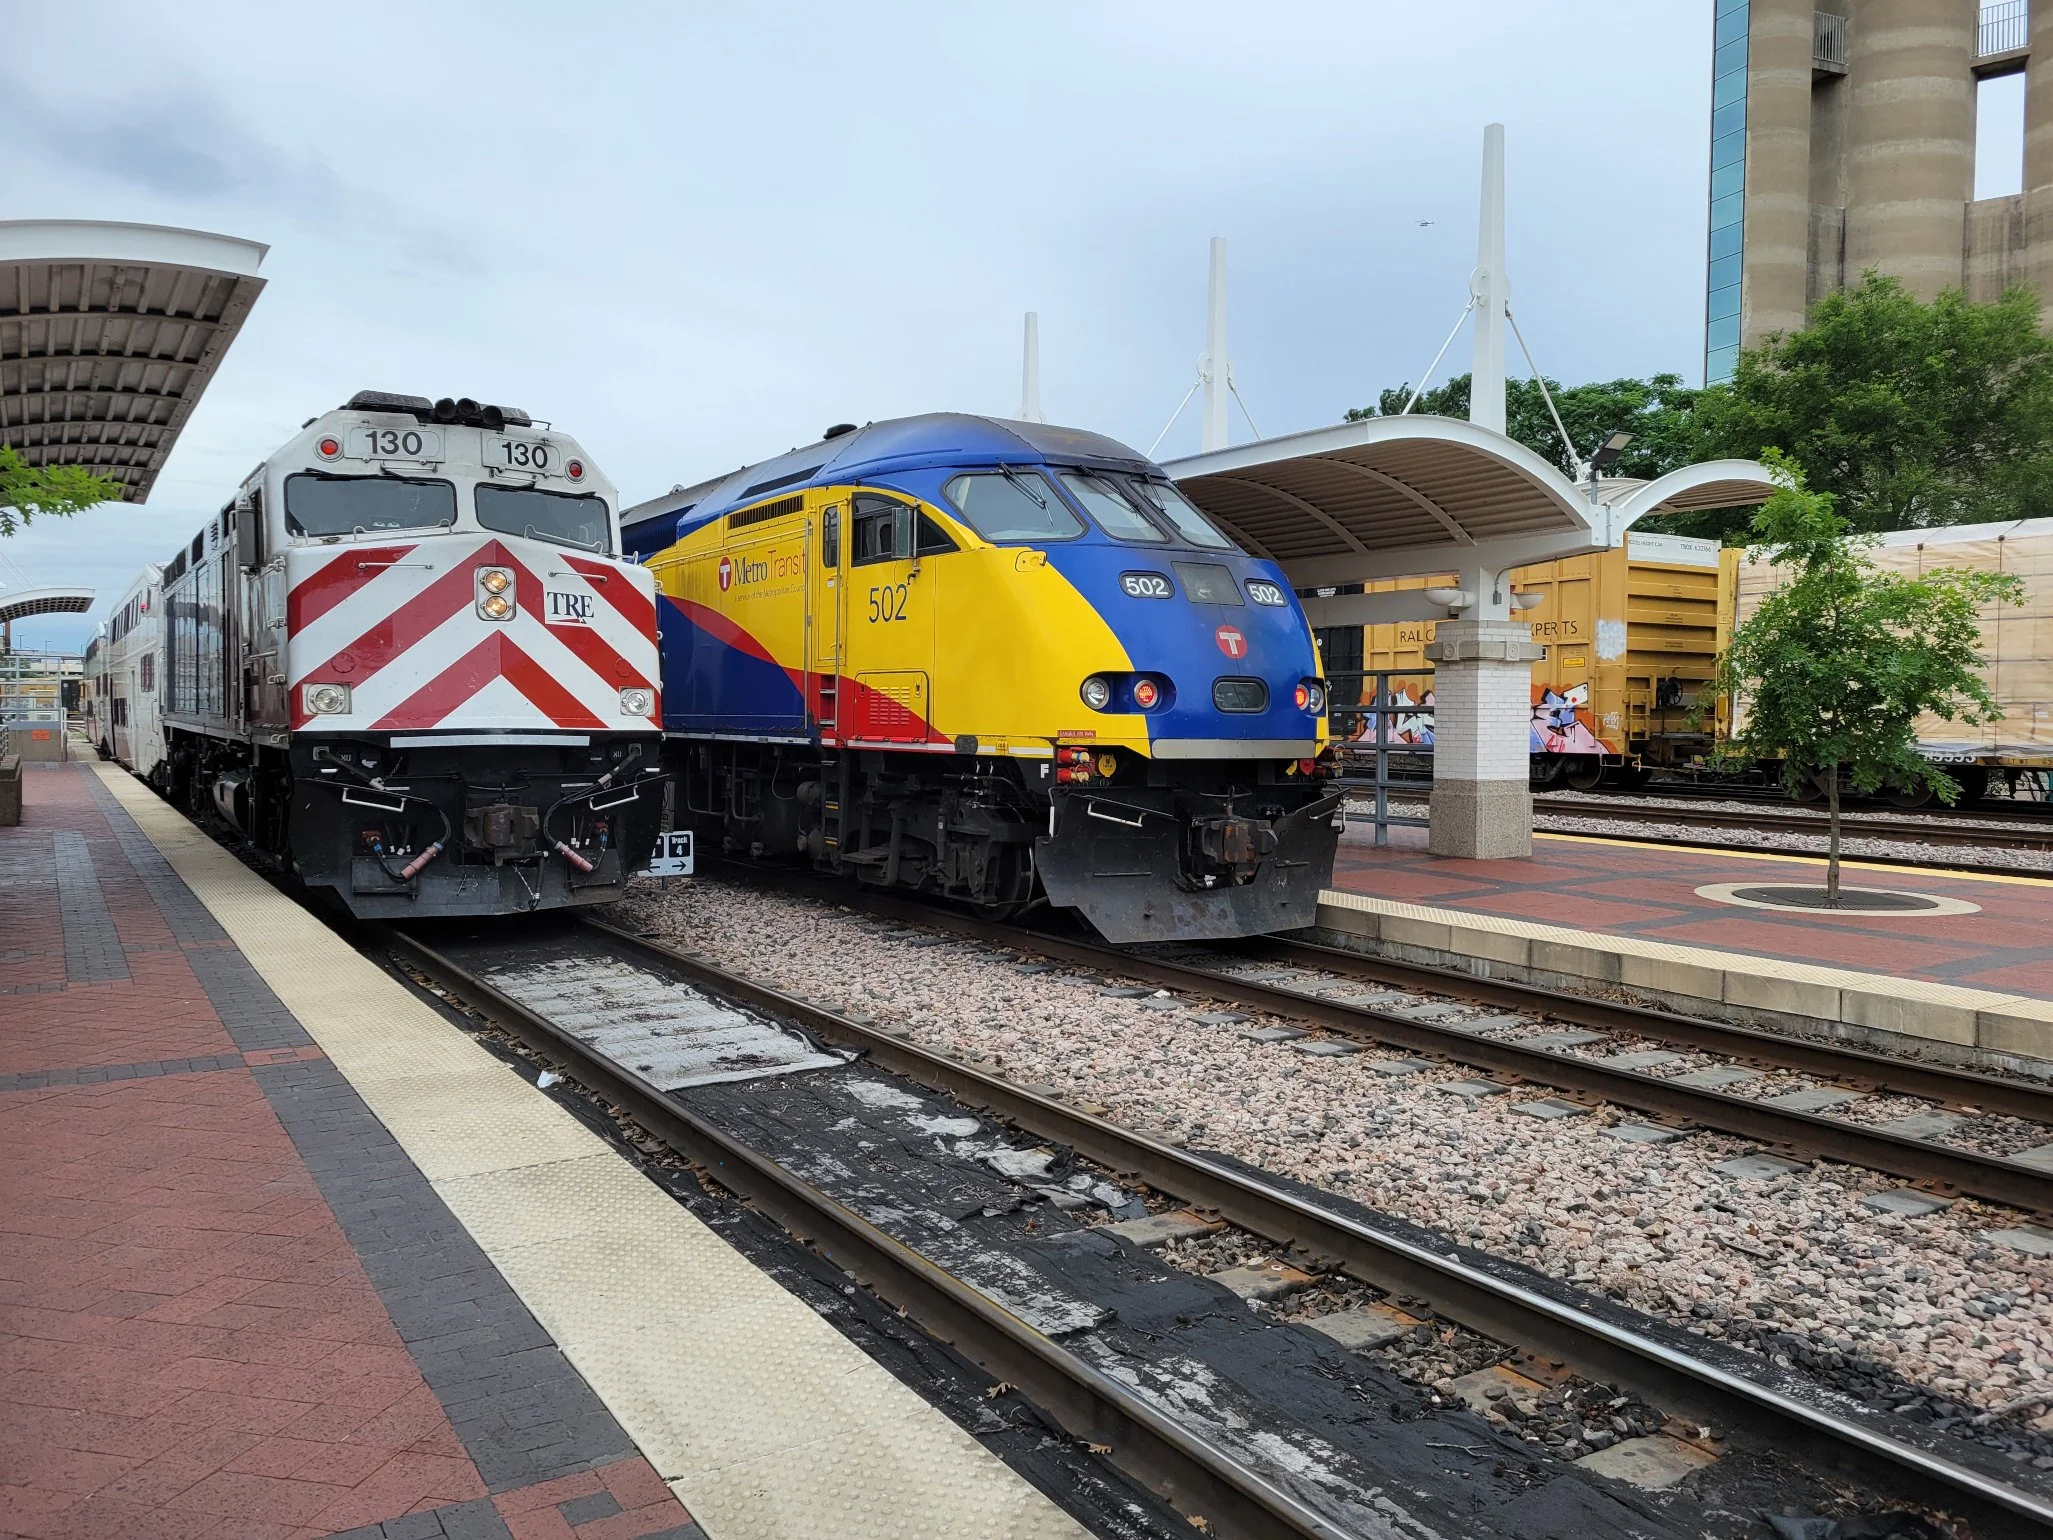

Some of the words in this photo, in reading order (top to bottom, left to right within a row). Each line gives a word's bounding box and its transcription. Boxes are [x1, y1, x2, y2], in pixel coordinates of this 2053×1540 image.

[365, 430, 423, 456] 130
[501, 441, 548, 469] 130
[1125, 577, 1169, 596] 502
[1248, 584, 1284, 605] 502
[546, 591, 595, 622] TRE
[868, 583, 908, 623] 502
[1531, 620, 1578, 637] PERTS
[1218, 631, 1242, 655] T
[1040, 763, 1050, 779] F
[671, 835, 688, 845] Track
[676, 844, 683, 856] 4
